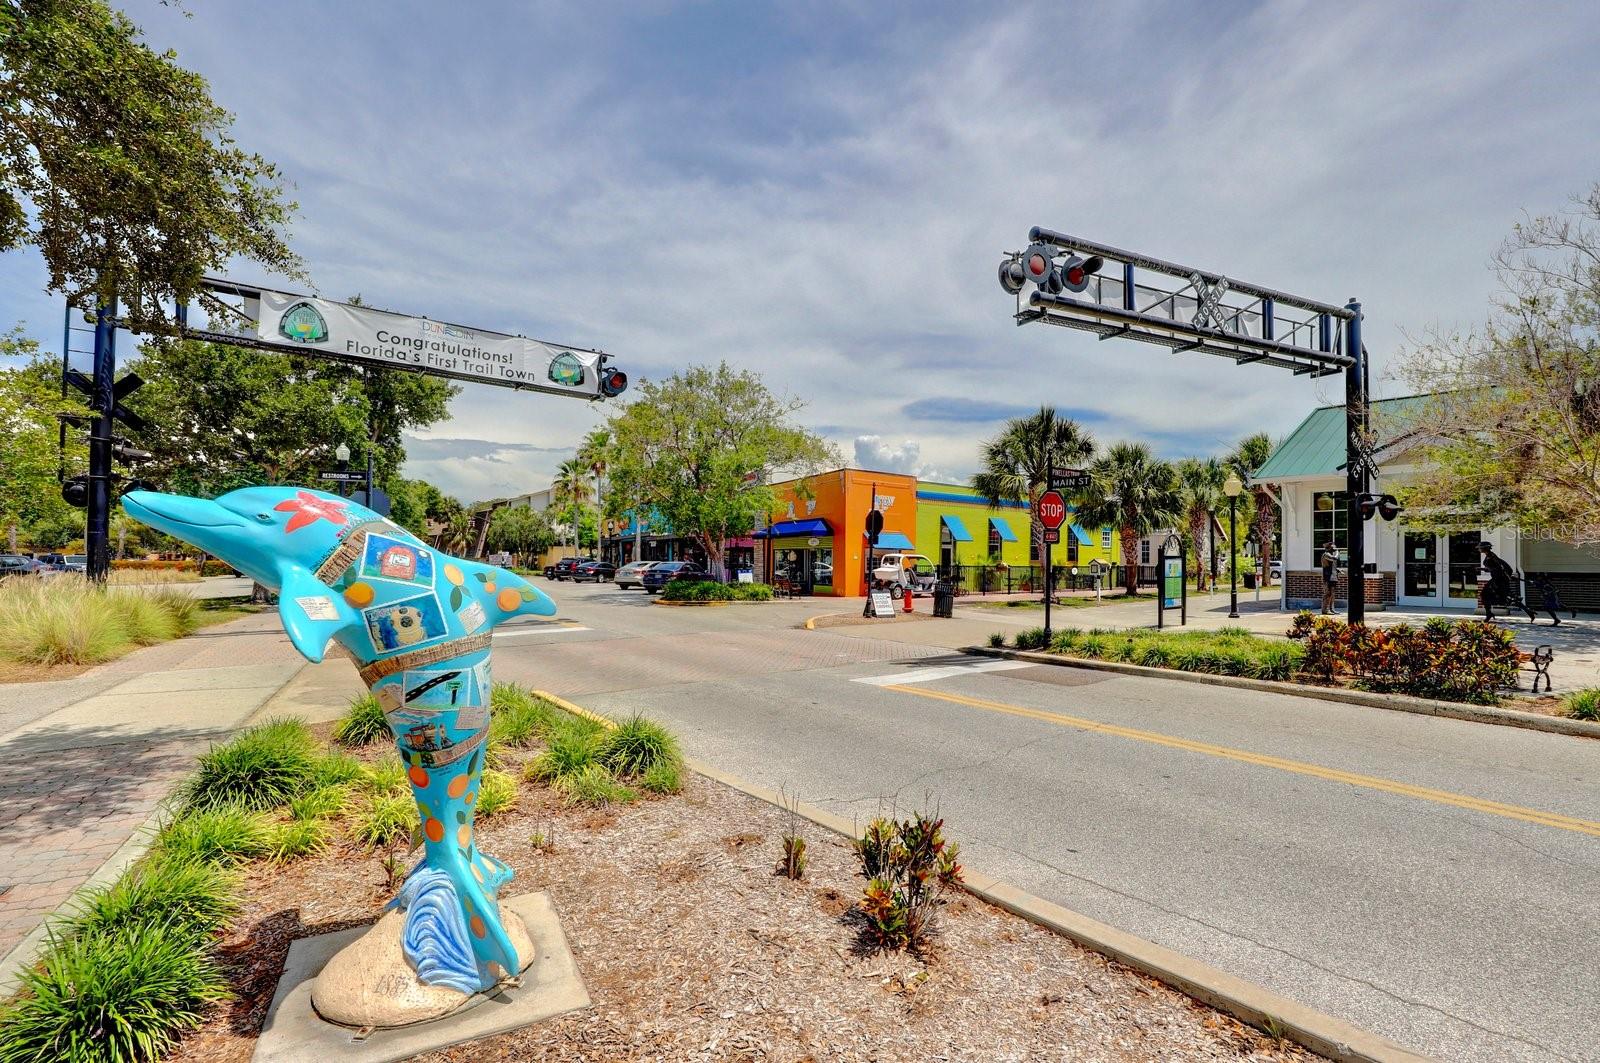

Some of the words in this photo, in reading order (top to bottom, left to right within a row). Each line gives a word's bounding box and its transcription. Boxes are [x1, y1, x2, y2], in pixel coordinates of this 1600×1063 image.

[1191, 273, 1206, 298] RAIL
[1212, 307, 1229, 332] ROAD
[1193, 278, 1228, 329] CROSSING
[346, 340, 420, 362] Florida's
[427, 353, 457, 368] First
[463, 359, 493, 374] Trail
[499, 365, 535, 381] Town
[376, 330, 513, 364] Congratulations!
[1351, 431, 1362, 451] RAIL
[1053, 479, 1075, 487] MAIN
[1079, 477, 1090, 485] ST
[1041, 503, 1063, 518] STOP
